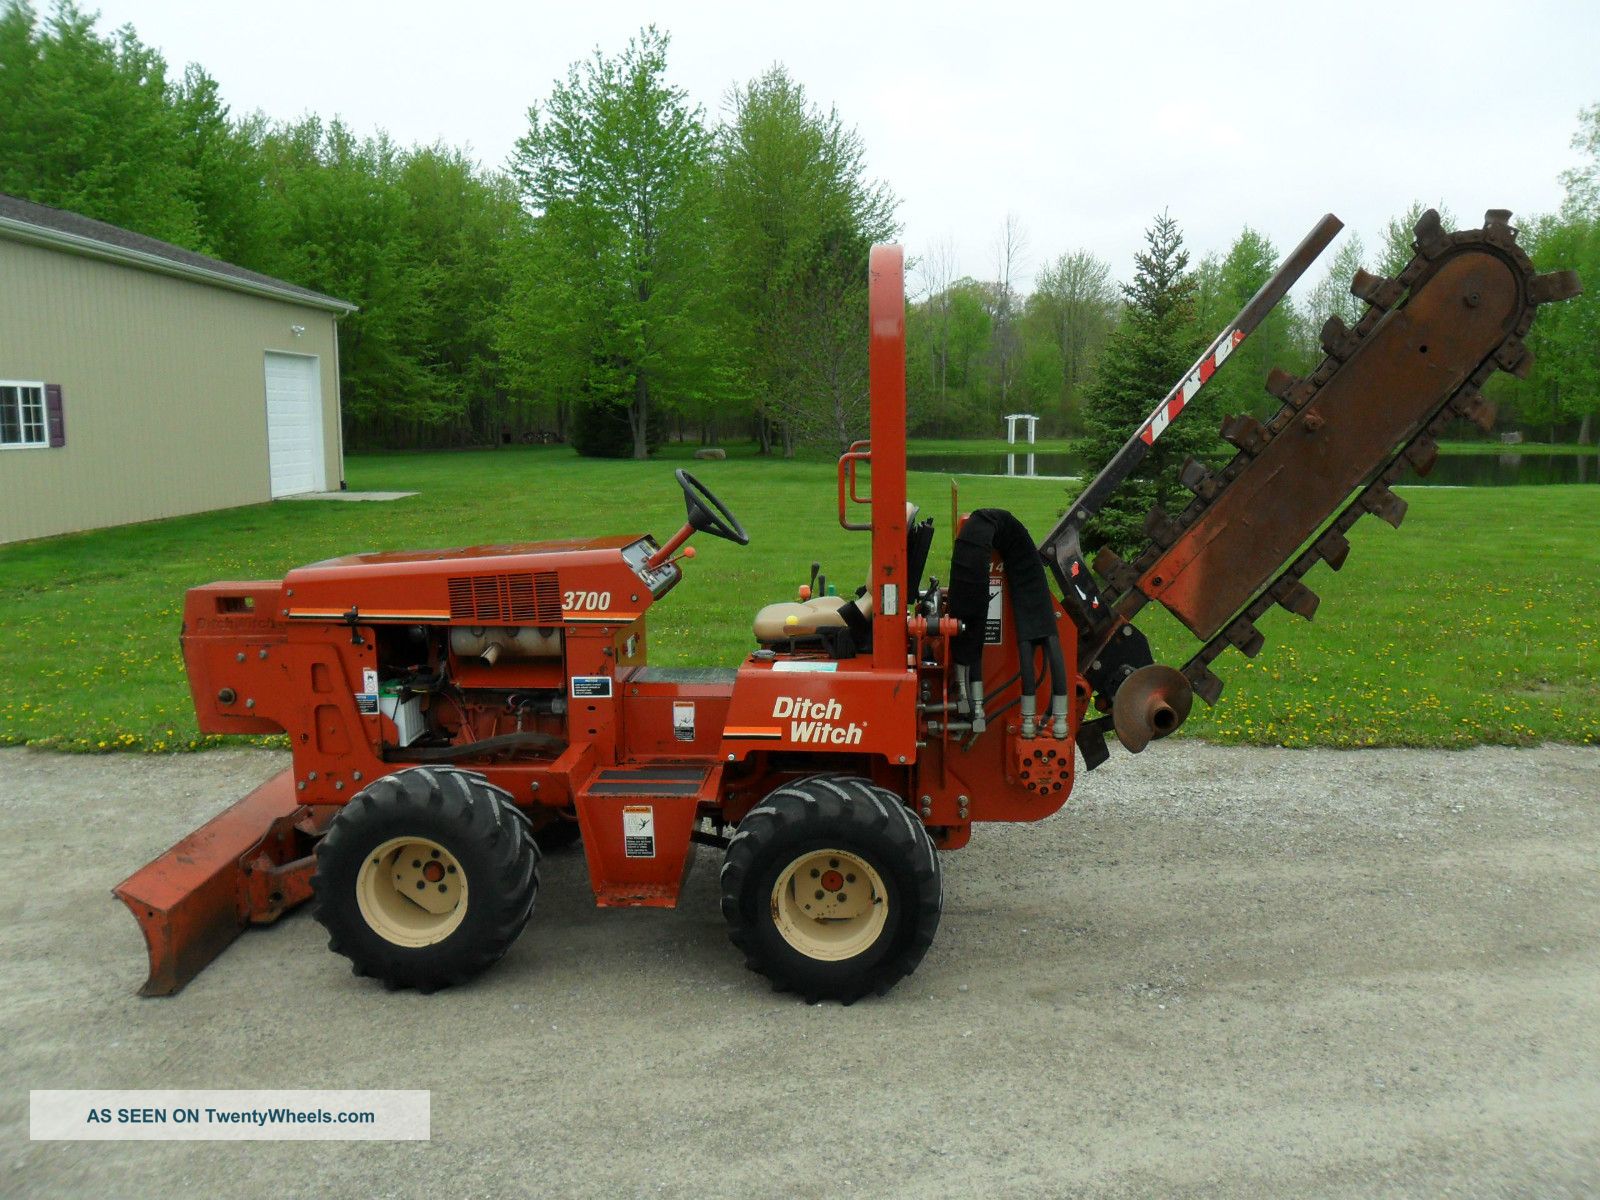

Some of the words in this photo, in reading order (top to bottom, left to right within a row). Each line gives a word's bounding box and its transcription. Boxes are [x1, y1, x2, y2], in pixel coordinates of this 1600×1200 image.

[561, 591, 611, 611] 3700
[772, 696, 843, 720] Ditch
[790, 720, 863, 745] Witch
